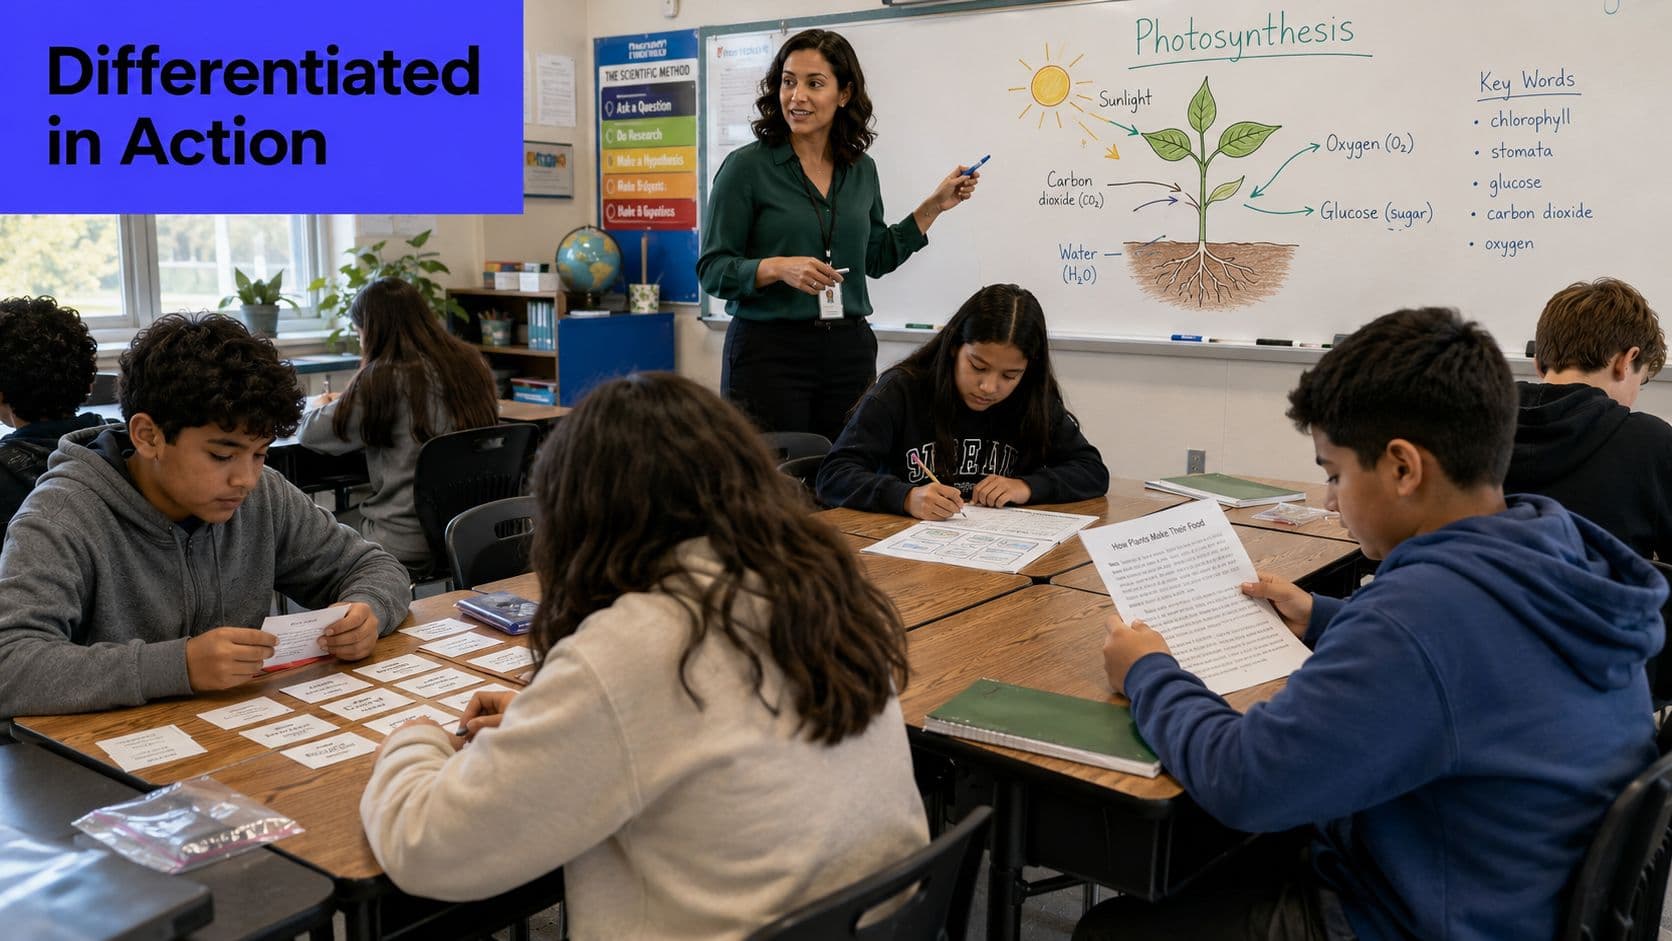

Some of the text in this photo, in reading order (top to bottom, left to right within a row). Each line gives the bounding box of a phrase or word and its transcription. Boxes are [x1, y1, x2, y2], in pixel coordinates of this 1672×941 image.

[1136, 11, 1354, 62] Photosynthesis
[605, 64, 690, 82] THE SCIENTIFIC METHOD
[1480, 68, 1575, 101] Key Words
[616, 102, 631, 114] Ask
[638, 100, 672, 115] Question
[1099, 88, 1152, 113] Sunlight
[1490, 107, 1570, 133] chlorophyll
[629, 127, 663, 141] Research
[1326, 133, 1380, 160] Oxygen
[1491, 141, 1553, 159] stomata
[1047, 170, 1093, 188] Carbon
[1489, 172, 1542, 198] glucose
[1039, 190, 1075, 206] dioxide
[1320, 200, 1433, 228] Glucose (sugar)
[1487, 202, 1593, 220] carbon dioxide
[1059, 243, 1098, 261] Water
[1485, 239, 1534, 257] oxygen
[1111, 519, 1206, 552] How Plants Make Their Food
